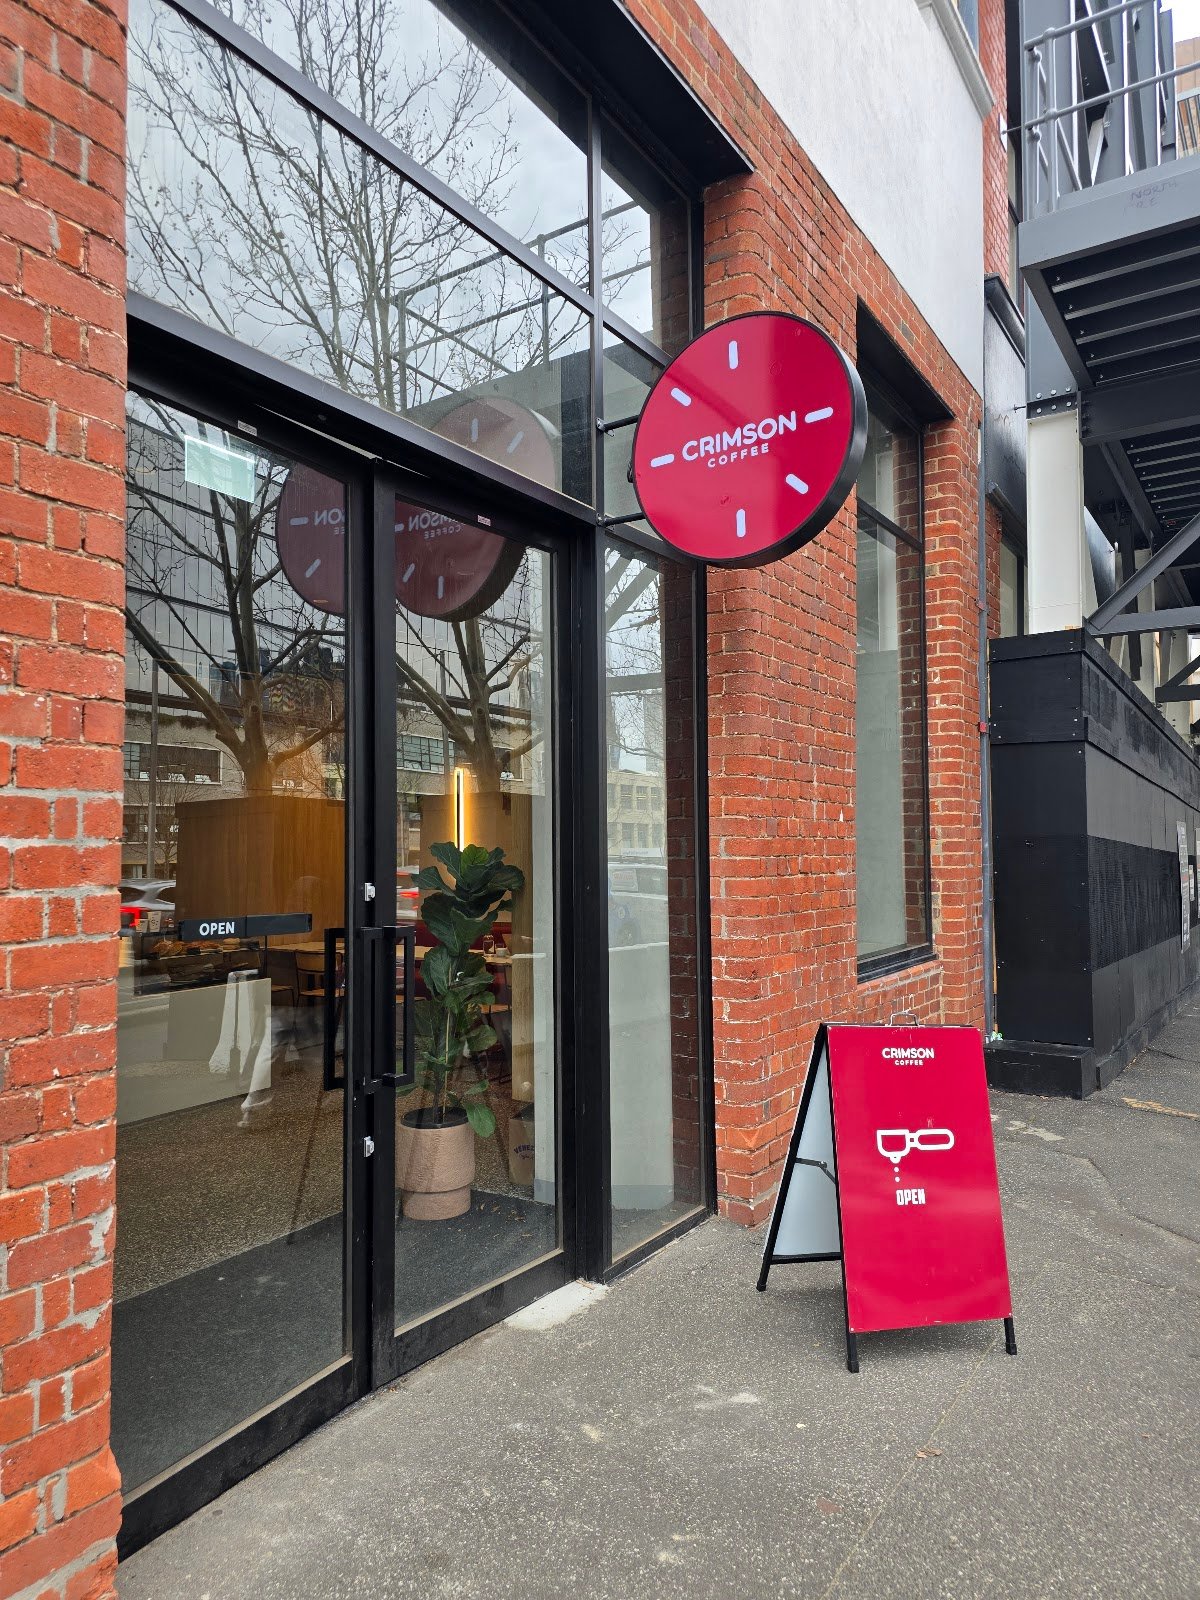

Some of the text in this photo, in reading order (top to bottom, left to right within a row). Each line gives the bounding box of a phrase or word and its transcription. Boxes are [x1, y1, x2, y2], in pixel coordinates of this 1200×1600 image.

[682, 410, 797, 461] CRIMSON
[707, 442, 769, 468] COFFEE
[199, 921, 235, 936] OPEN
[881, 1047, 935, 1059] CRIMSON
[895, 1188, 926, 1206] OPEN
